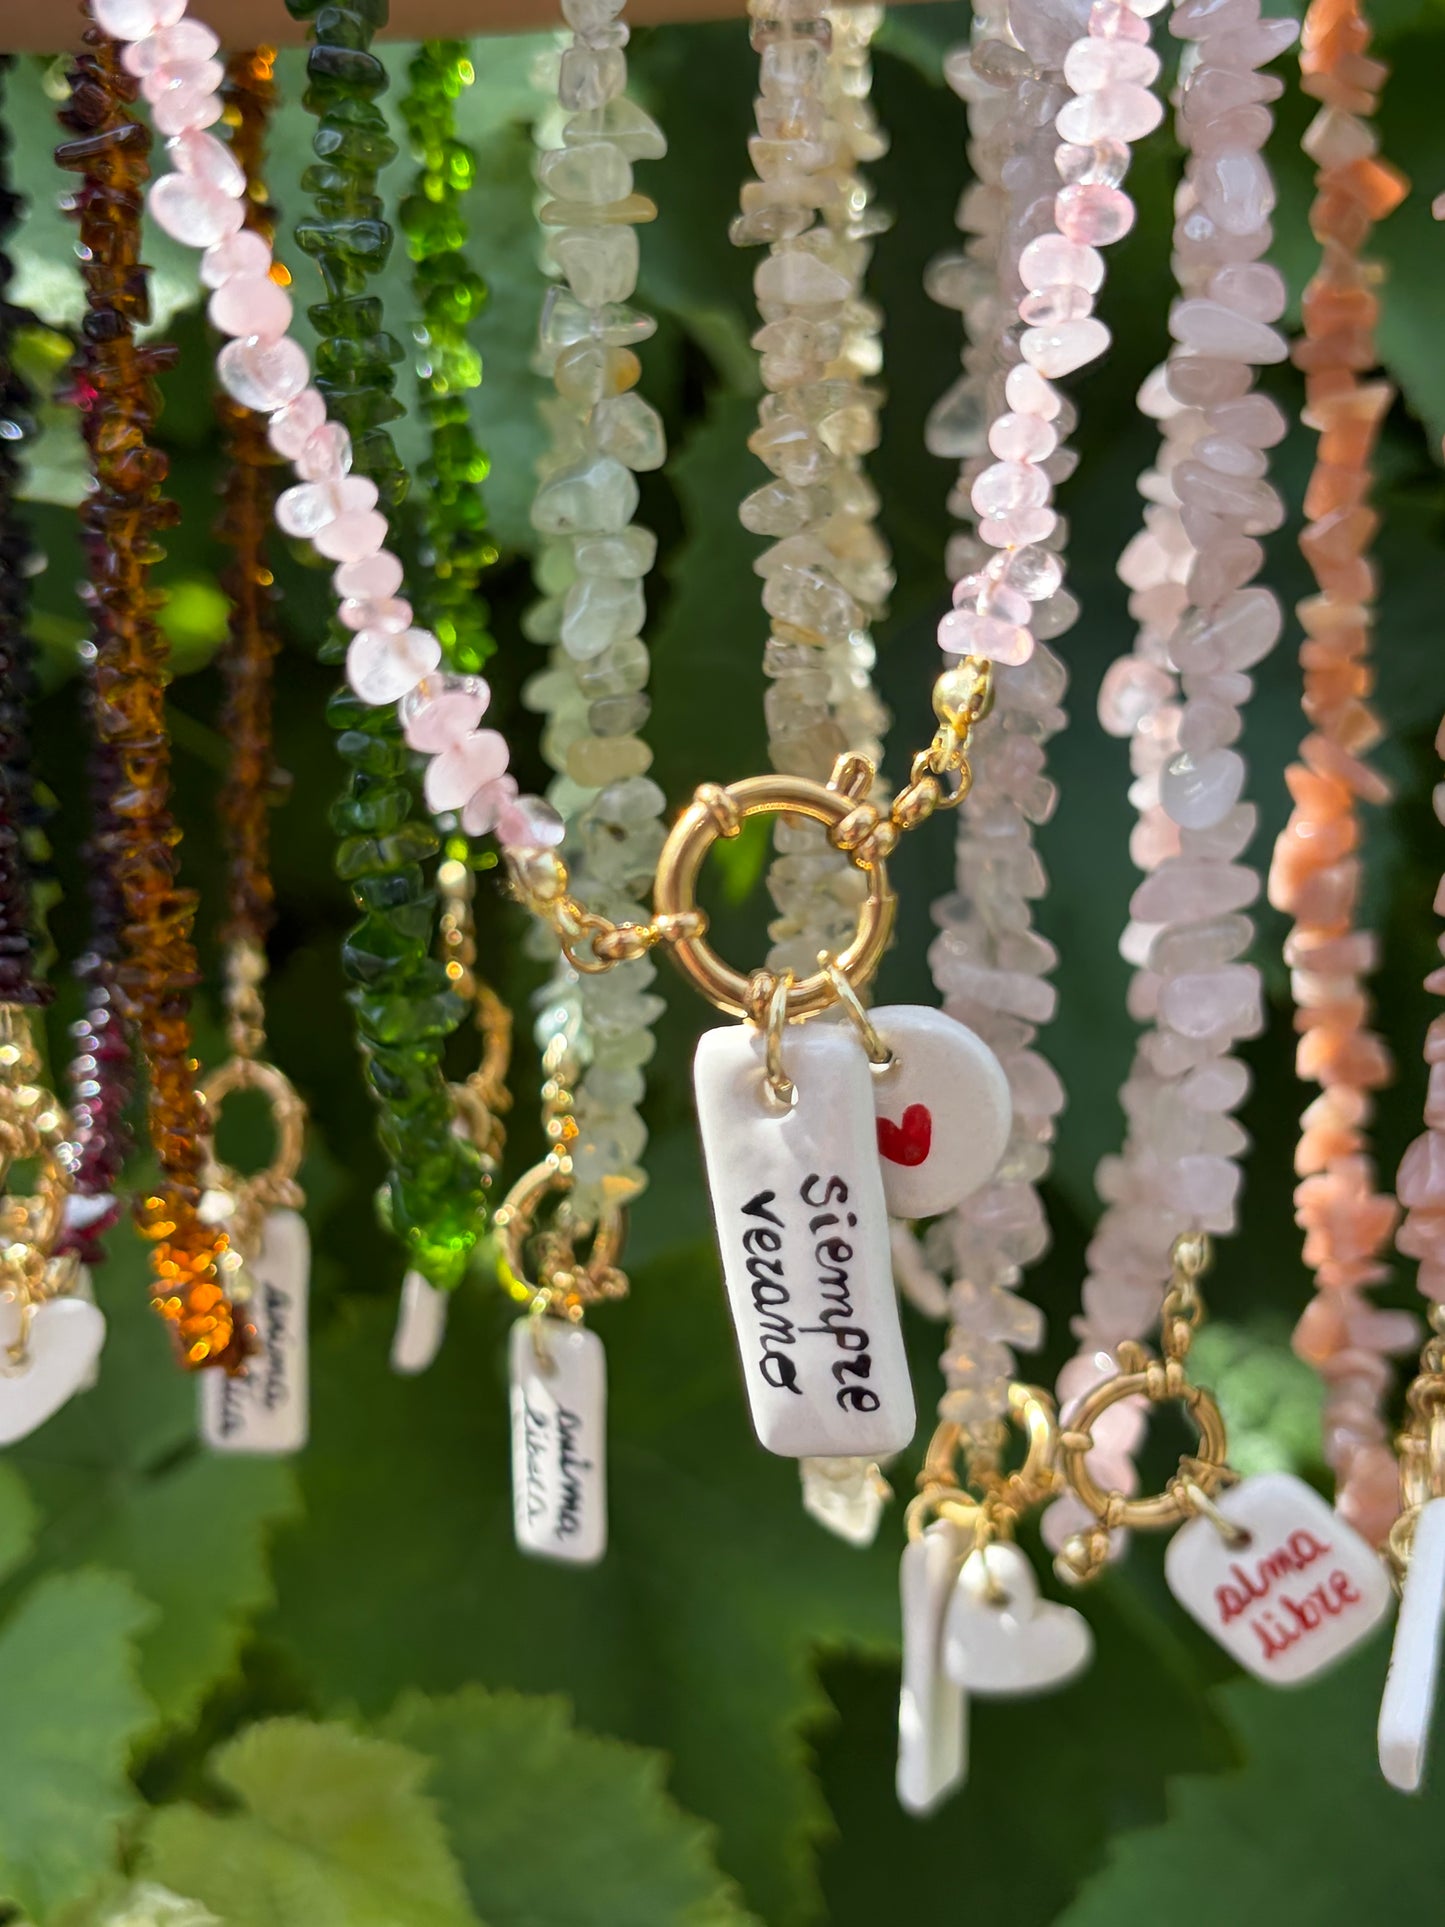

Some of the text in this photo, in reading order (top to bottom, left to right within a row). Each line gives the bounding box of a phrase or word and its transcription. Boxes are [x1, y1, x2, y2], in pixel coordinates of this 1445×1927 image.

[740, 1188, 803, 1395] verano
[798, 1172, 881, 1413] siempre
[556, 1402, 593, 1543] anima
[1213, 1527, 1332, 1625] alma
[1250, 1568, 1364, 1660] libre
